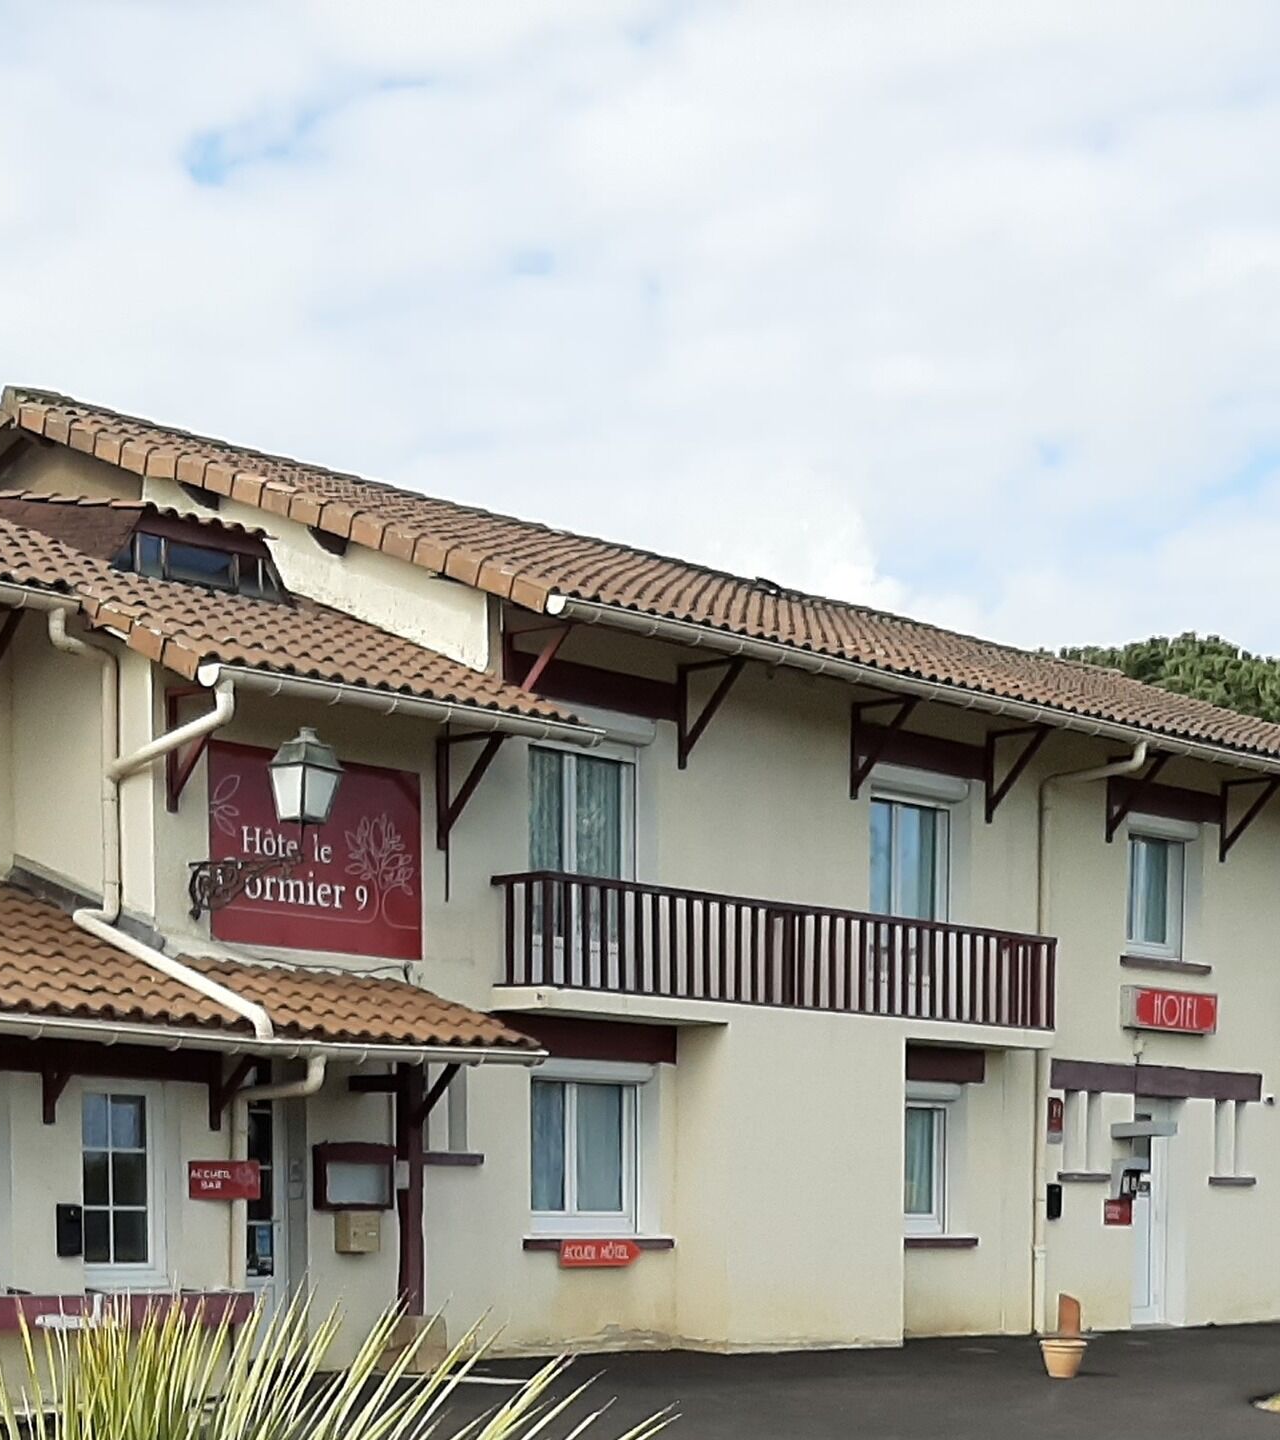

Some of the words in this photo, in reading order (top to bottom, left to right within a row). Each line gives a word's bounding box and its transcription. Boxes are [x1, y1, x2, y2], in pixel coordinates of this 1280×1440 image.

[241, 825, 305, 858] Hôte
[313, 834, 332, 864] le
[217, 864, 345, 909] ormier
[355, 885, 367, 911] 9
[1153, 993, 1198, 1028] HOTEL
[200, 1180, 222, 1190] BAR
